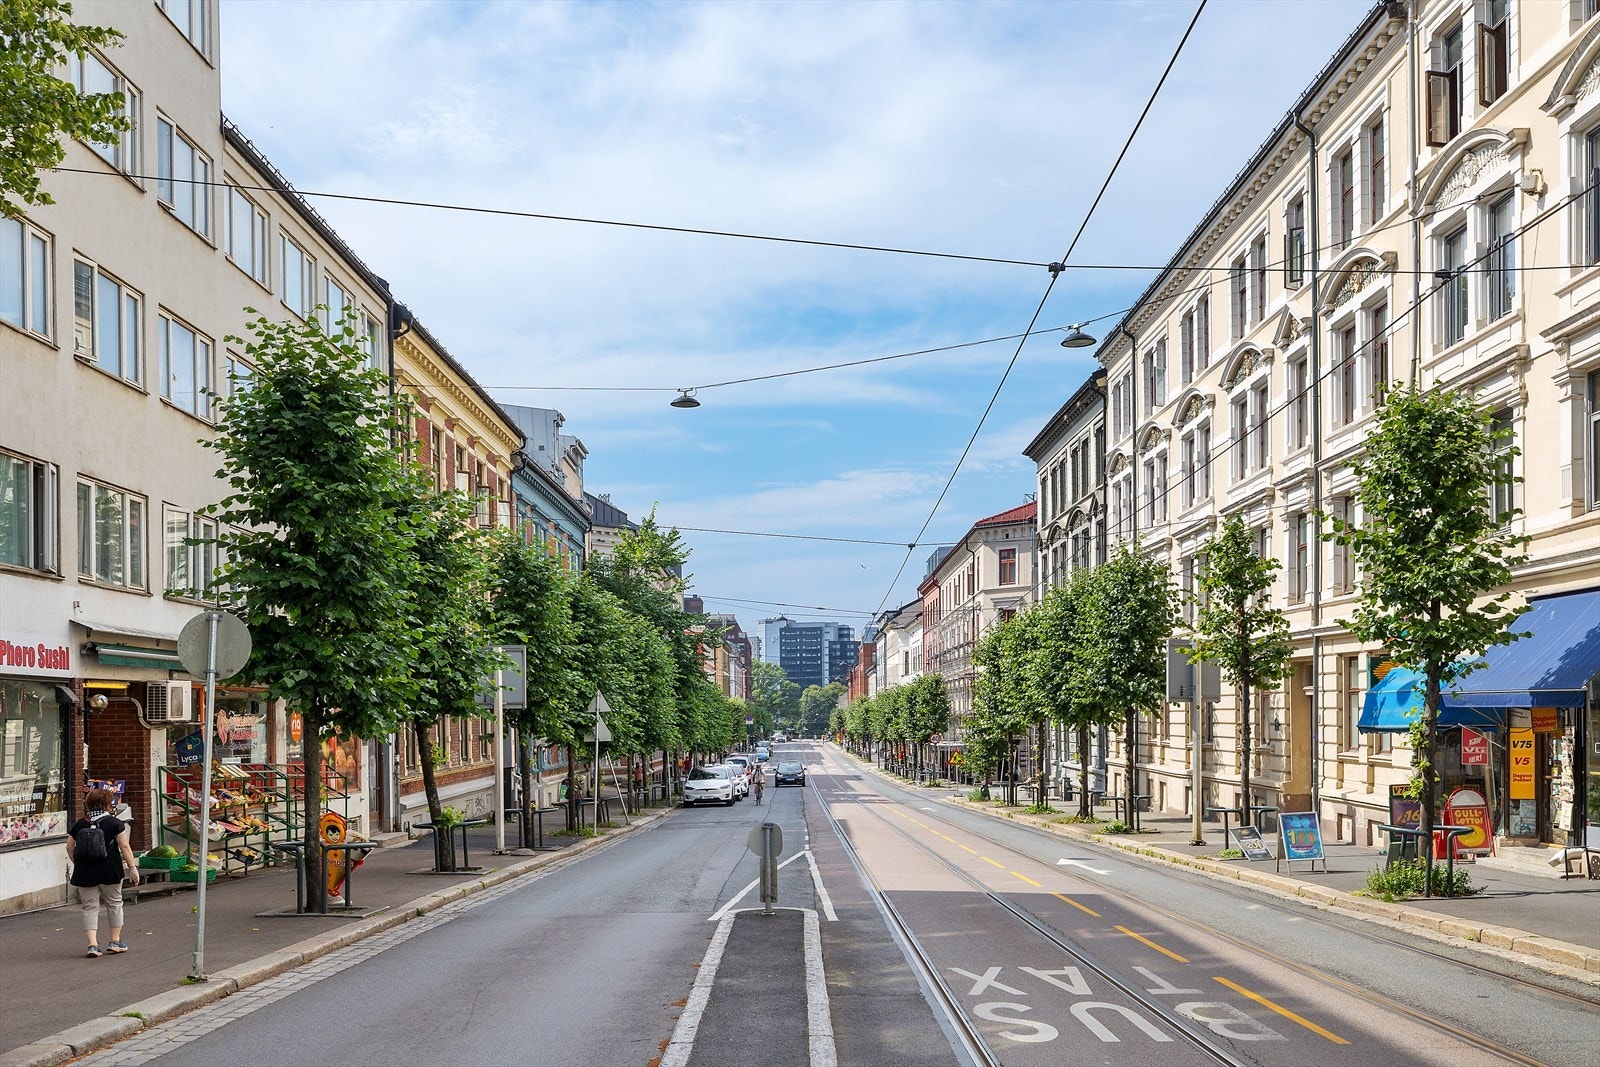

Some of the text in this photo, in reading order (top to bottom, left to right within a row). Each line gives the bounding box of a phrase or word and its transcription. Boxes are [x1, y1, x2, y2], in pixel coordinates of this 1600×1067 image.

[38, 643, 69, 670] Sushi
[291, 713, 301, 730] ria
[1532, 715, 1557, 725] Dagens
[1533, 721, 1556, 729] Dobbel
[1512, 740, 1532, 749] V75
[181, 755, 199, 763] Lyca
[1514, 757, 1530, 765] V5
[1393, 787, 1410, 795] V75
[1454, 809, 1482, 818] GULL-
[1456, 817, 1483, 825] LOTTO!
[947, 965, 1205, 996] TAX
[972, 1001, 1289, 1043] BUS
